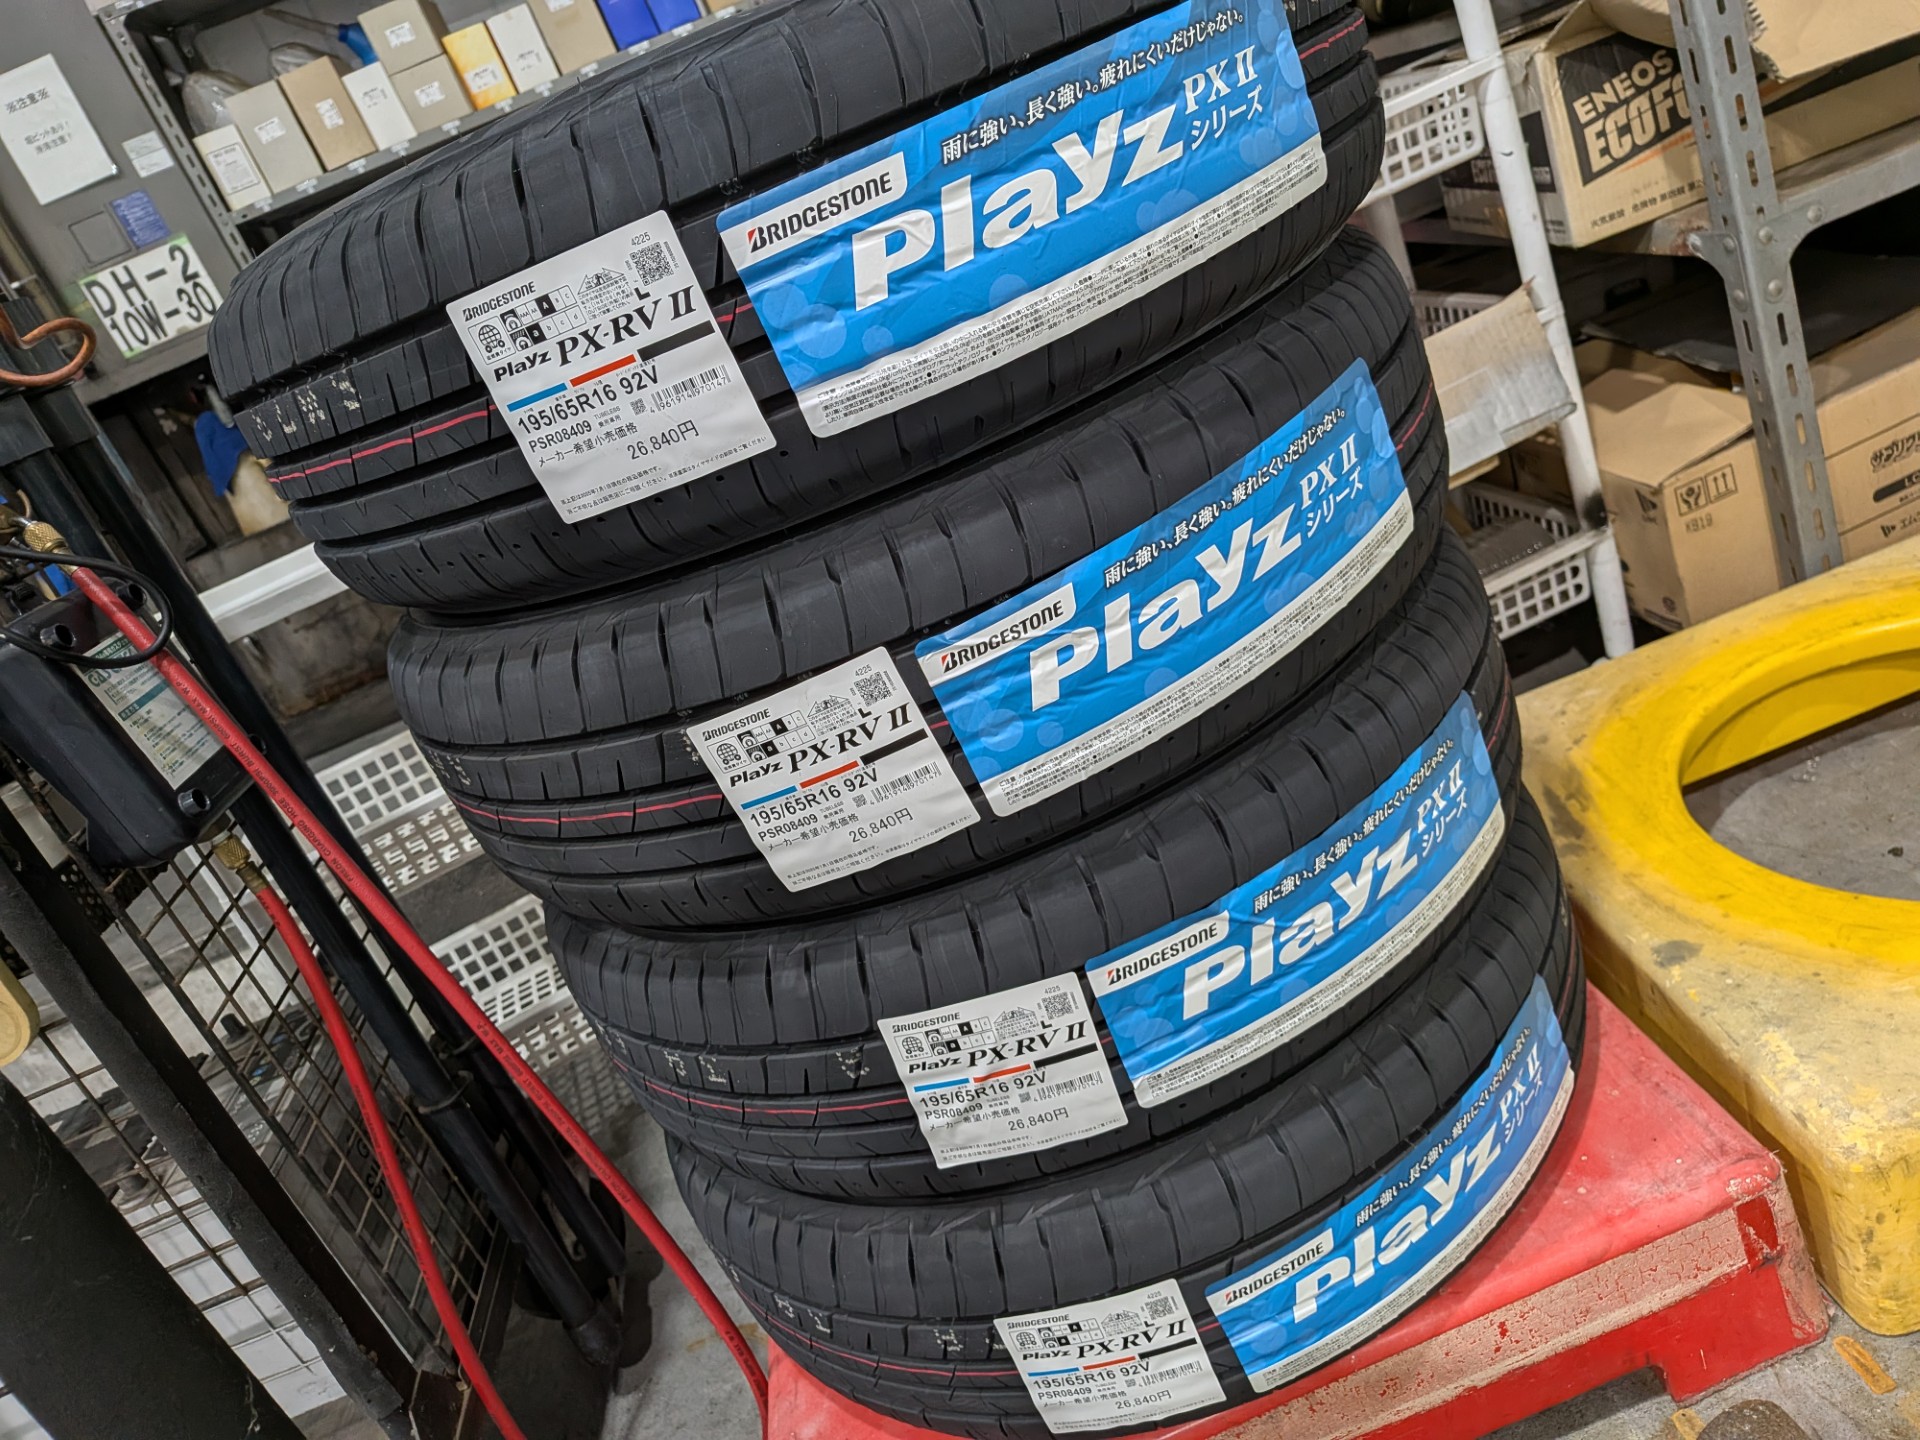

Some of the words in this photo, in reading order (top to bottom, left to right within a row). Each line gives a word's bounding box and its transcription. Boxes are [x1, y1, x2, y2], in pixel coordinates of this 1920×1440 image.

[941, 9, 1245, 165] 雨に強い、長く強い。疲れにくいだけじゃない。
[1573, 49, 1675, 123] ENEOS
[1191, 88, 1264, 152] シリーズ
[852, 106, 1185, 313] Playz
[1184, 57, 1233, 117] PX
[747, 171, 892, 254] BRIDGESTONE
[631, 232, 651, 246] 4225
[85, 244, 200, 318] DH-2
[462, 281, 537, 322] BRIDGESTONE
[542, 301, 549, 310] A
[634, 285, 650, 300] L
[108, 281, 217, 353] 10W-30
[493, 352, 551, 383] Playz
[557, 302, 666, 368] PX-RV
[518, 383, 618, 436] 195/65R16
[620, 366, 660, 396] 92V
[529, 420, 592, 453] PSR08409
[538, 422, 639, 468] メーカー希望小売価格
[627, 420, 699, 462] 26,840円
[1105, 409, 1346, 588] 雨に強い、長く強い。疲れにくいだけじゃない。
[1306, 473, 1364, 537] シリーズ
[1029, 506, 1302, 712] Playz
[1299, 466, 1341, 511] PX
[942, 600, 1064, 673] BRIDGESTONE
[854, 664, 872, 677] 4225
[702, 709, 770, 741] BRIDGESTONE
[230, 740, 255, 767] BURST
[729, 762, 783, 788] Playz
[789, 715, 883, 774] PX-RV
[277, 796, 298, 819] HOSE
[750, 785, 842, 827] 195/65R16
[844, 768, 879, 793] 92V
[758, 814, 819, 842] PSR08409
[767, 813, 860, 852] メーカー希望小売価格
[848, 808, 913, 844] 26,840円
[1422, 793, 1468, 857] シリーズ
[1183, 831, 1419, 1022] Playz
[1416, 787, 1448, 830] PX
[1107, 922, 1218, 986] BRIDGESTONE
[892, 1012, 960, 1034] BRIDGESTONE
[909, 1056, 962, 1074] Playz
[967, 1030, 1058, 1068] PX-RV
[919, 1081, 1010, 1109] 195/65R16
[1013, 1071, 1047, 1090] 92V
[925, 1102, 983, 1120] PSR08409
[1008, 1107, 1070, 1132] 26,840円
[1226, 1241, 1324, 1306] BRIDGESTONE
